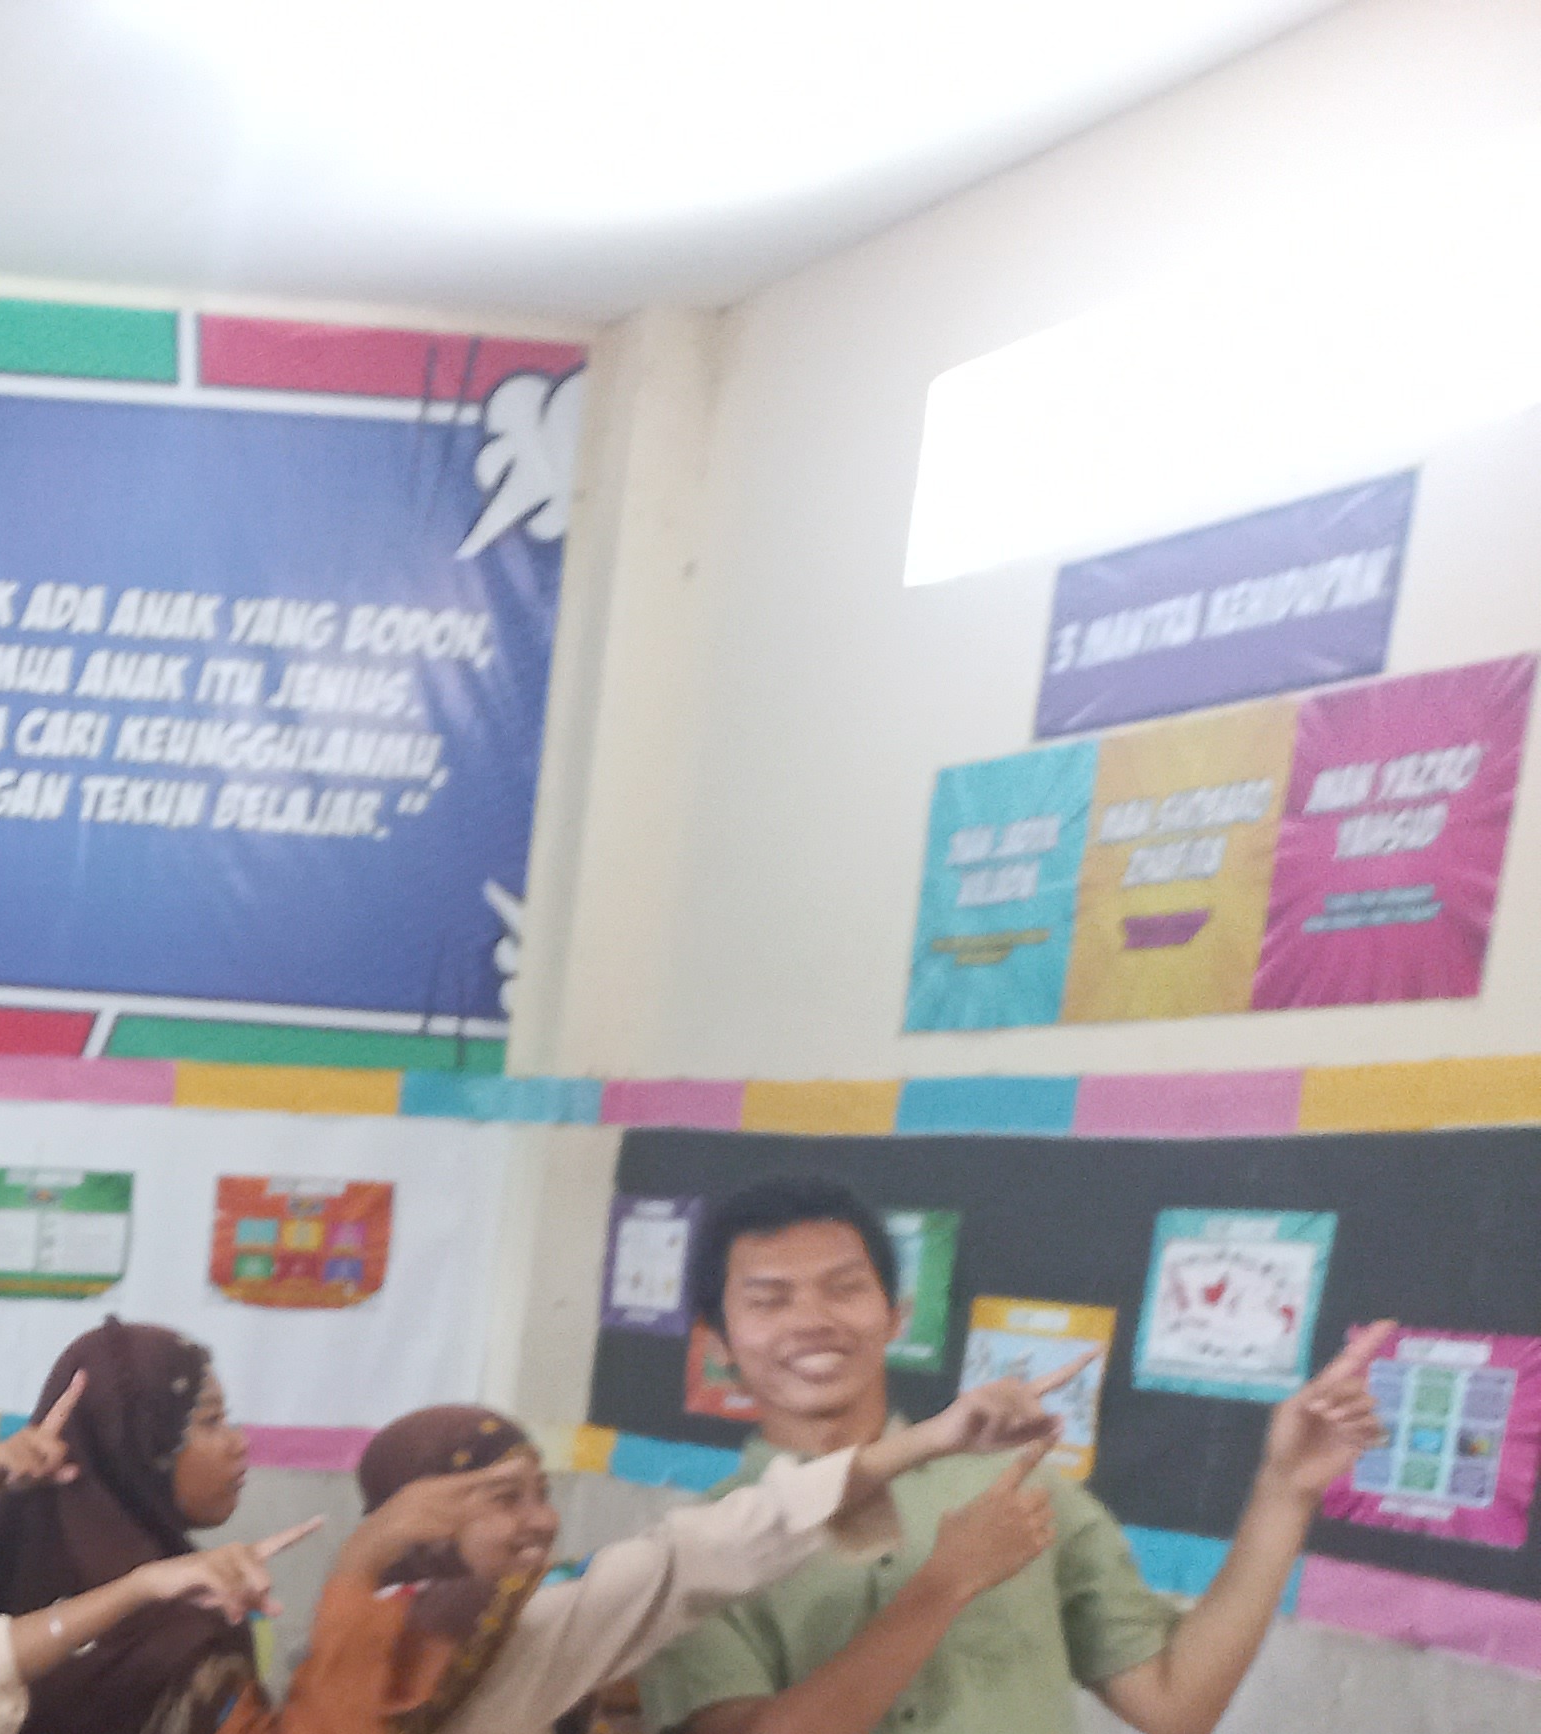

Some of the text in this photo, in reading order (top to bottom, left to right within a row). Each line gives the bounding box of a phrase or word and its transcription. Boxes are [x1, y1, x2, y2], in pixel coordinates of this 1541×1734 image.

[19, 581, 107, 632] ADA
[106, 586, 222, 641] ANAK
[229, 596, 338, 654] YANG
[74, 648, 193, 700] ANAK
[196, 657, 266, 706] ITU
[15, 707, 109, 760] CARI
[78, 774, 210, 829] TEKUN
